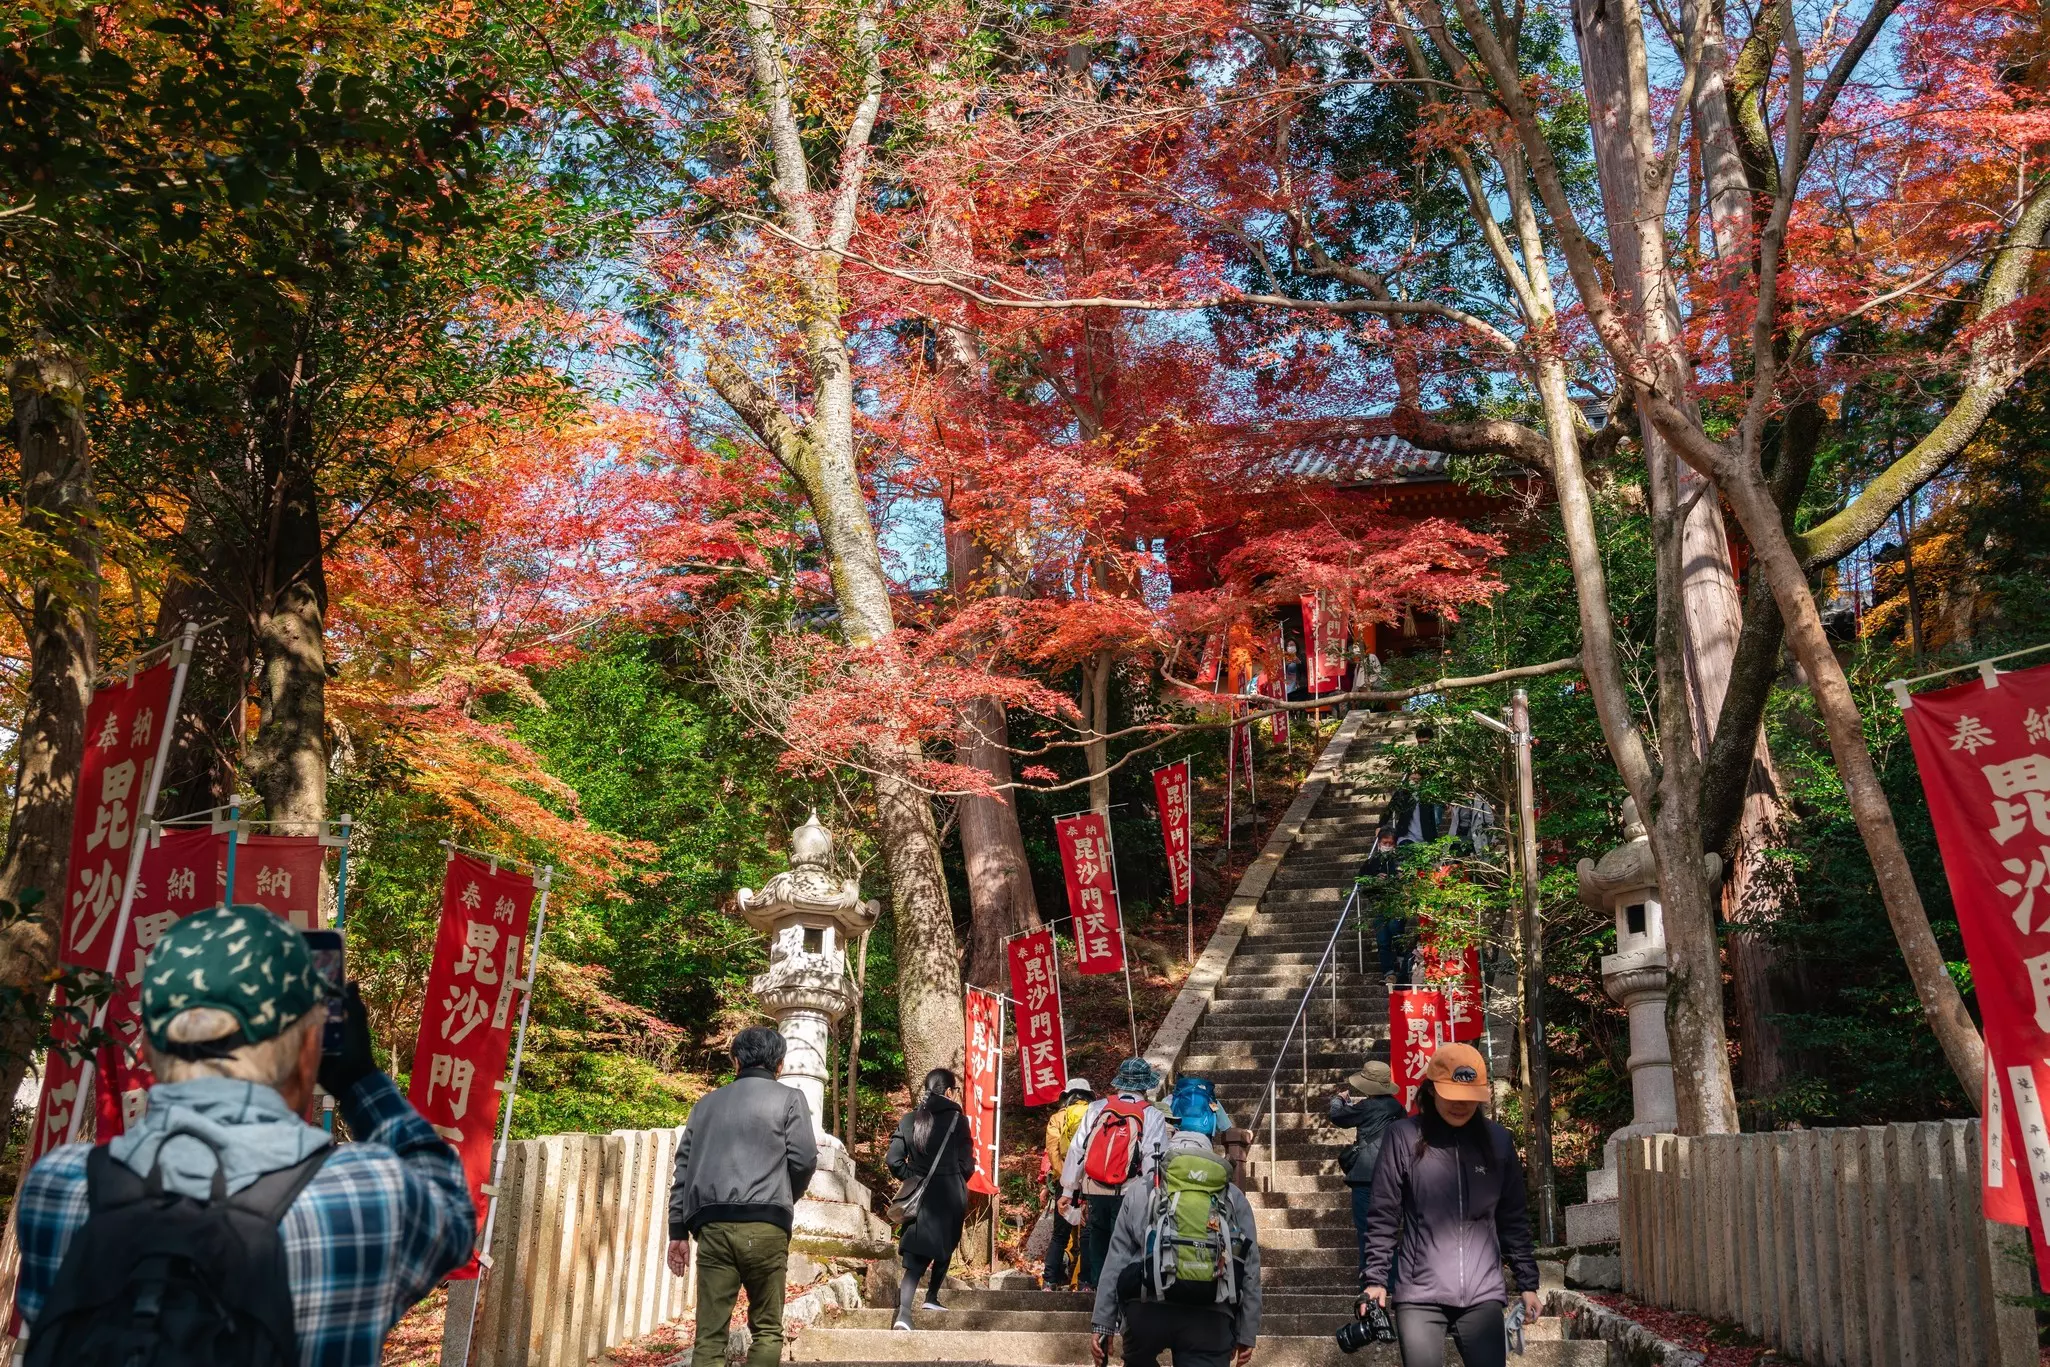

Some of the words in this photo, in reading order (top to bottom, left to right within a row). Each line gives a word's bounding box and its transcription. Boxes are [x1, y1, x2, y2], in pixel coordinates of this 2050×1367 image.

[97, 707, 153, 754] 奉納
[1161, 773, 1182, 786] 奉納
[1066, 825, 1097, 836] 奉納
[1166, 784, 1189, 891] 毘沙門天王
[461, 881, 516, 925] 奉納
[1074, 837, 1112, 958] 毘沙門天王
[1017, 943, 1045, 959] 奉納
[1025, 957, 1060, 1089] 毘沙門天王
[1400, 1000, 1436, 1017] 奉納
[427, 920, 499, 1155] 毘沙門
